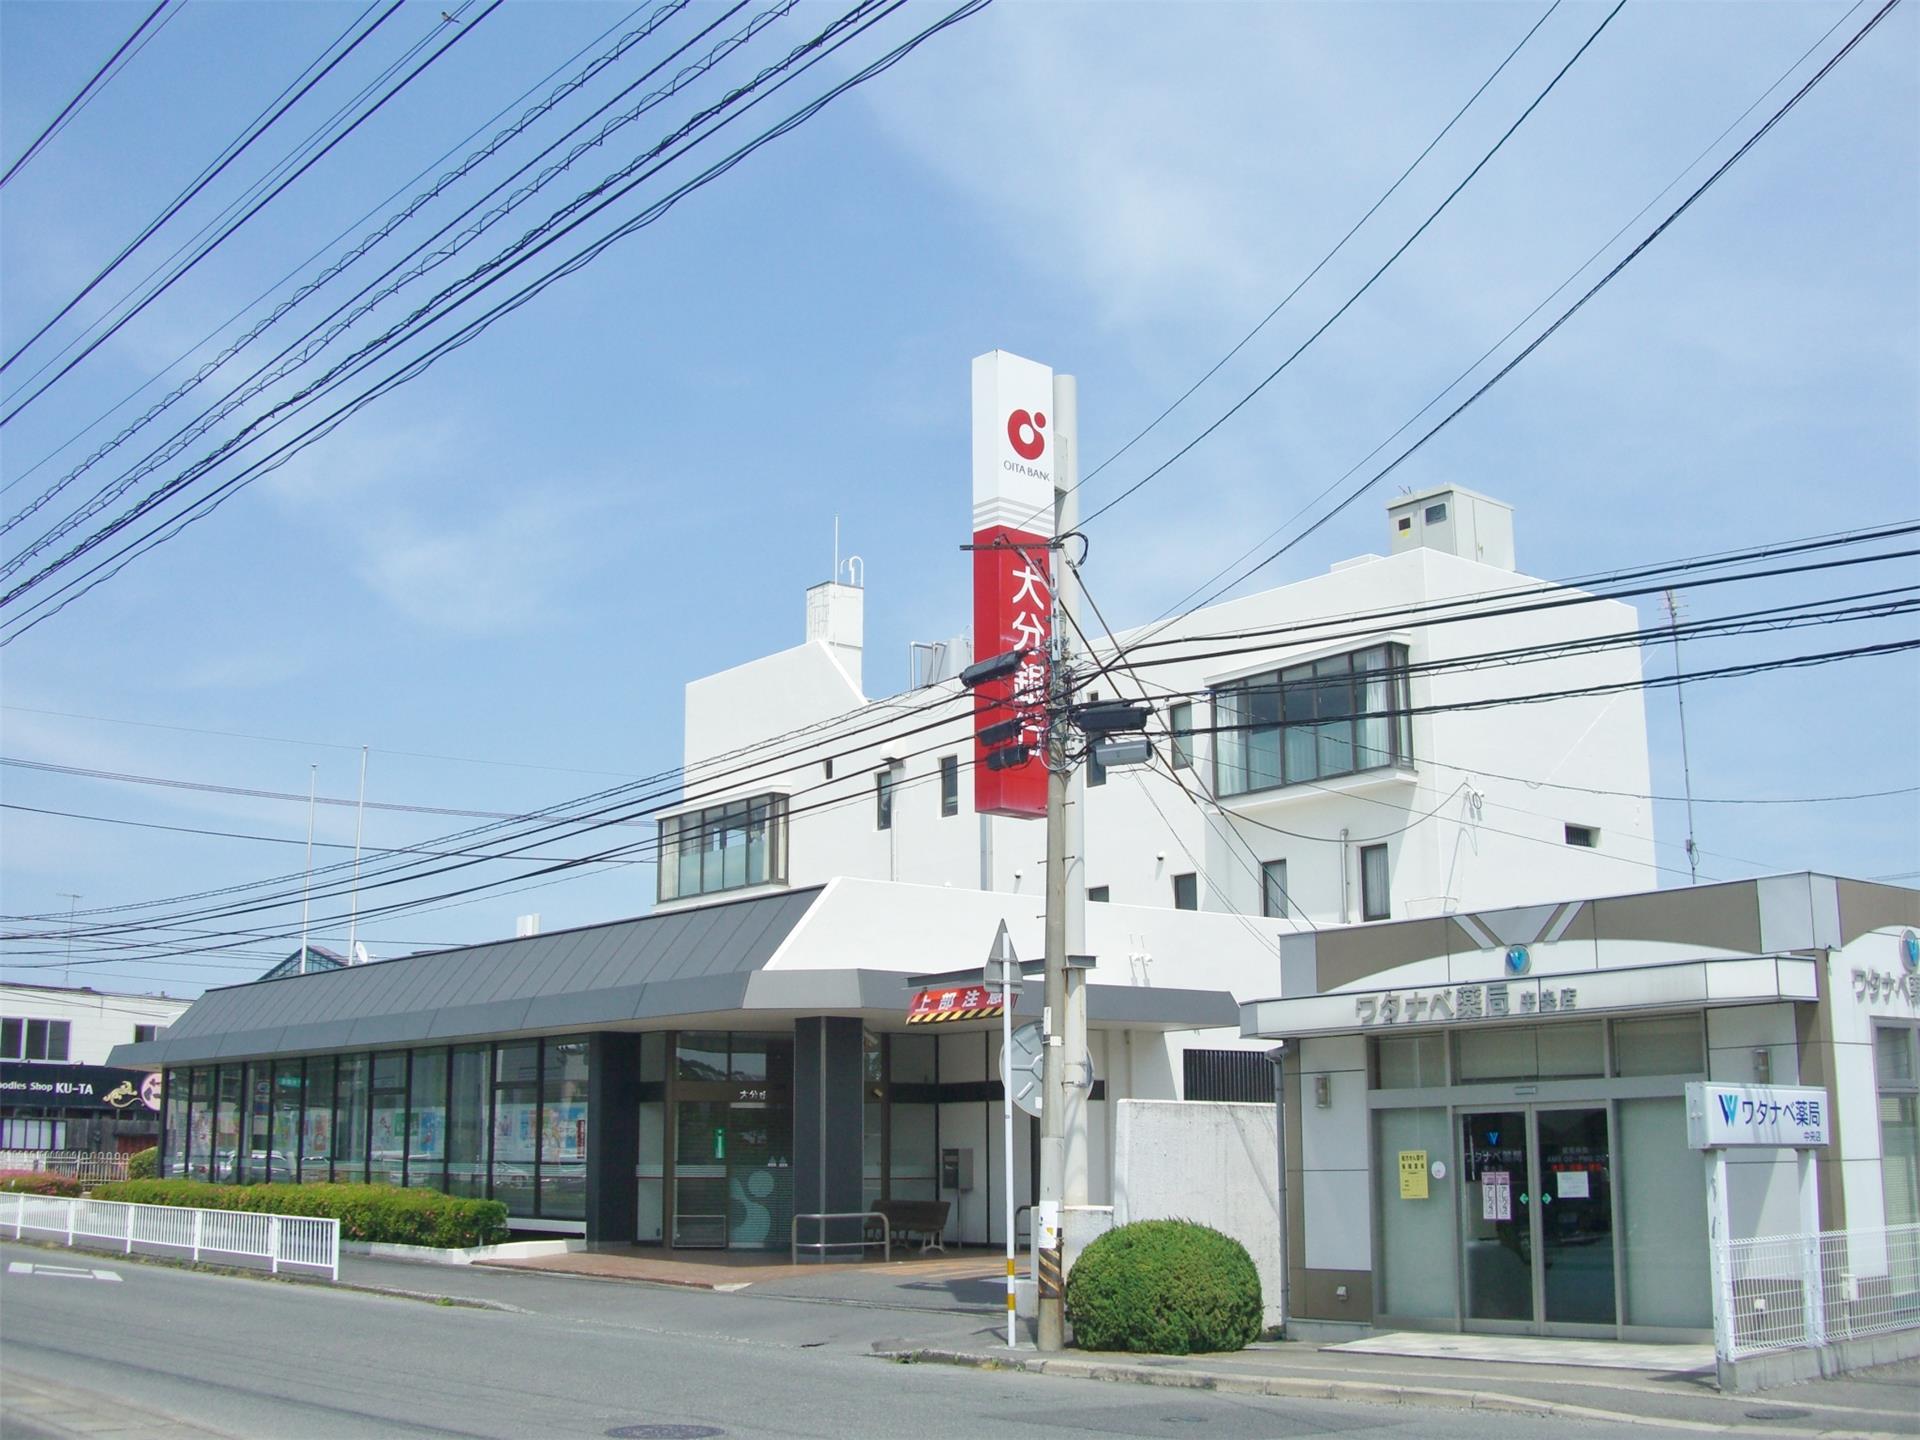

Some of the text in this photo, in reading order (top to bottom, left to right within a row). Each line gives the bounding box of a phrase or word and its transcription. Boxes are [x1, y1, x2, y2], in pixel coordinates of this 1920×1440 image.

[1003, 460, 1050, 481] OITA BANK
[1355, 984, 1578, 1026] ワタナベ薬局 中央店
[30, 1082, 53, 1092] Shop
[56, 1083, 94, 1095] KU-TA
[1742, 1100, 1820, 1127] ワタナベ薬局
